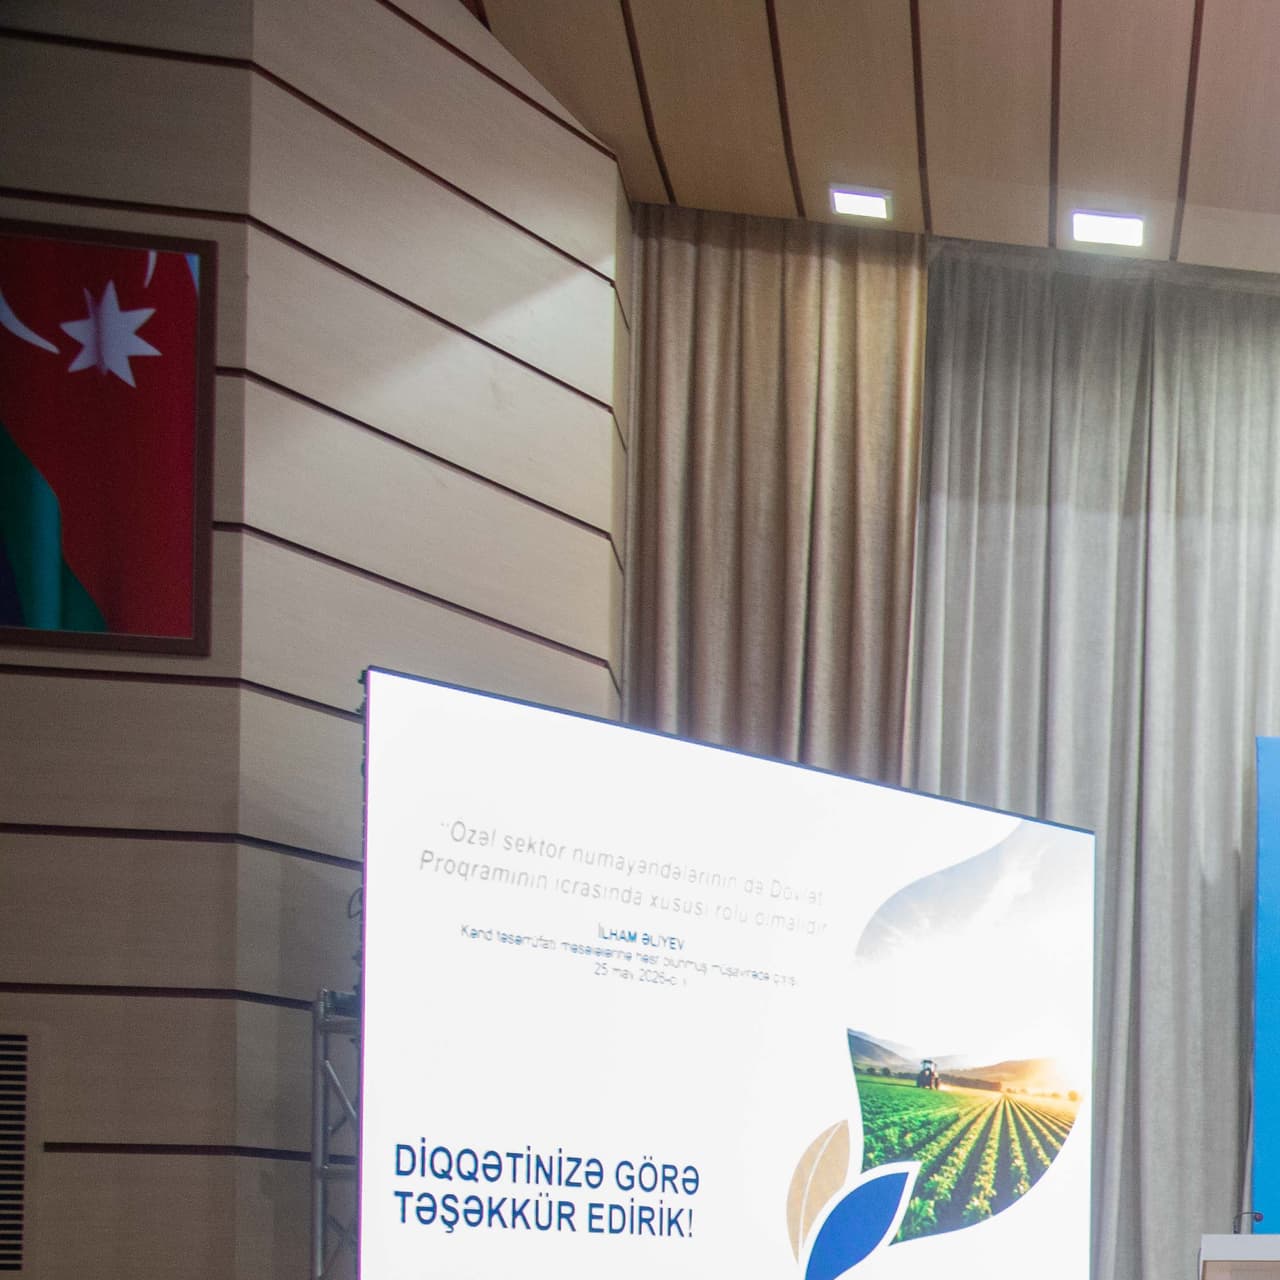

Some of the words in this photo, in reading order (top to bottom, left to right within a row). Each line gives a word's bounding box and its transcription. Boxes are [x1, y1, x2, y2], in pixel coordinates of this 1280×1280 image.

[503, 834, 567, 859] sektor
[394, 1136, 605, 1190] DİQQƏTİNİZƏ
[614, 1155, 700, 1196] GÖRƏ
[392, 1189, 577, 1234] TƏŞƏKKÜR
[587, 1196, 693, 1238] EDİRİK!
